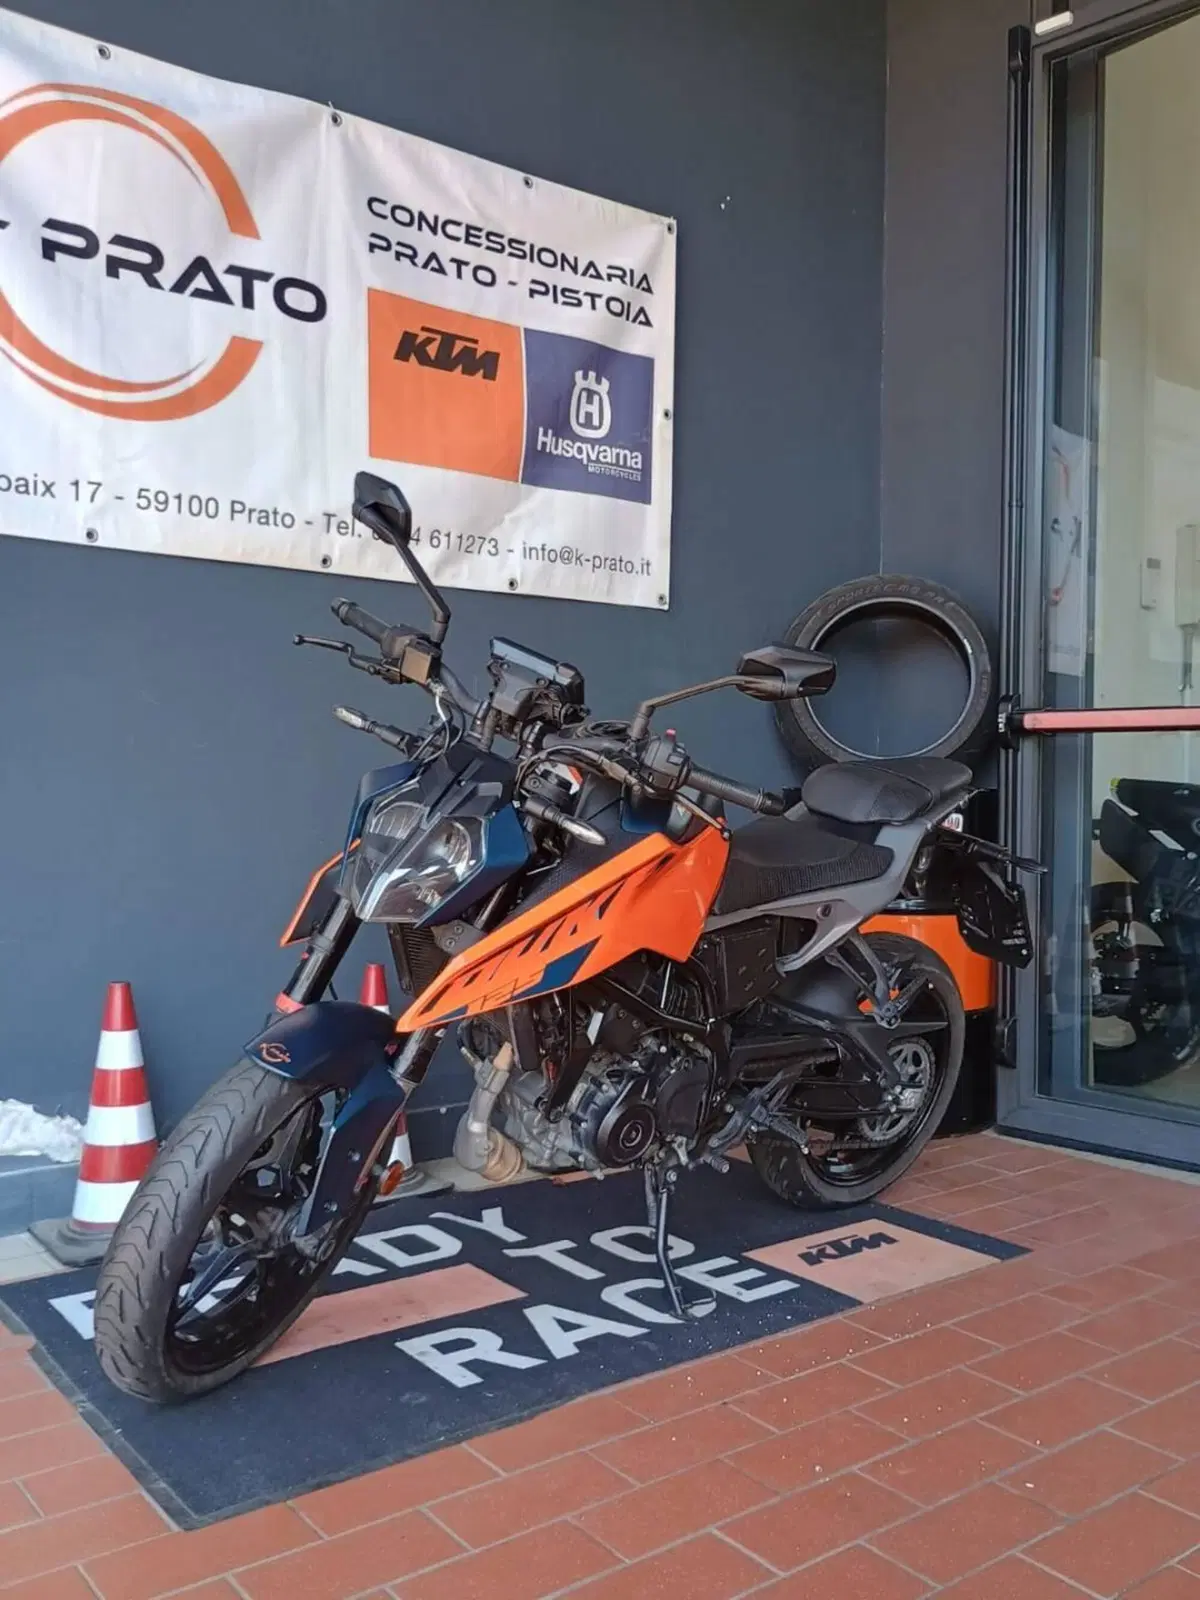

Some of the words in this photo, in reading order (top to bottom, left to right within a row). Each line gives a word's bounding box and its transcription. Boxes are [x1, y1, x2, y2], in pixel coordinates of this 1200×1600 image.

[41, 217, 328, 323] PRATO
[367, 196, 654, 295] CONCESSIONARIA
[368, 232, 497, 288] PRATO
[529, 278, 654, 328] PISTOIA
[393, 326, 500, 381] KTM
[537, 426, 643, 470] Husqvarna
[587, 464, 642, 482] MOTORCYCLES
[70, 478, 103, 503] 17
[136, 488, 220, 519] 59100
[230, 500, 296, 530] Prato
[322, 512, 363, 539] Tel.
[429, 529, 500, 557] 611273
[521, 541, 652, 577] info@k-prato.it
[502, 1225, 696, 1280] TO
[797, 1231, 899, 1267] KTM
[393, 1256, 800, 1388] RACE
